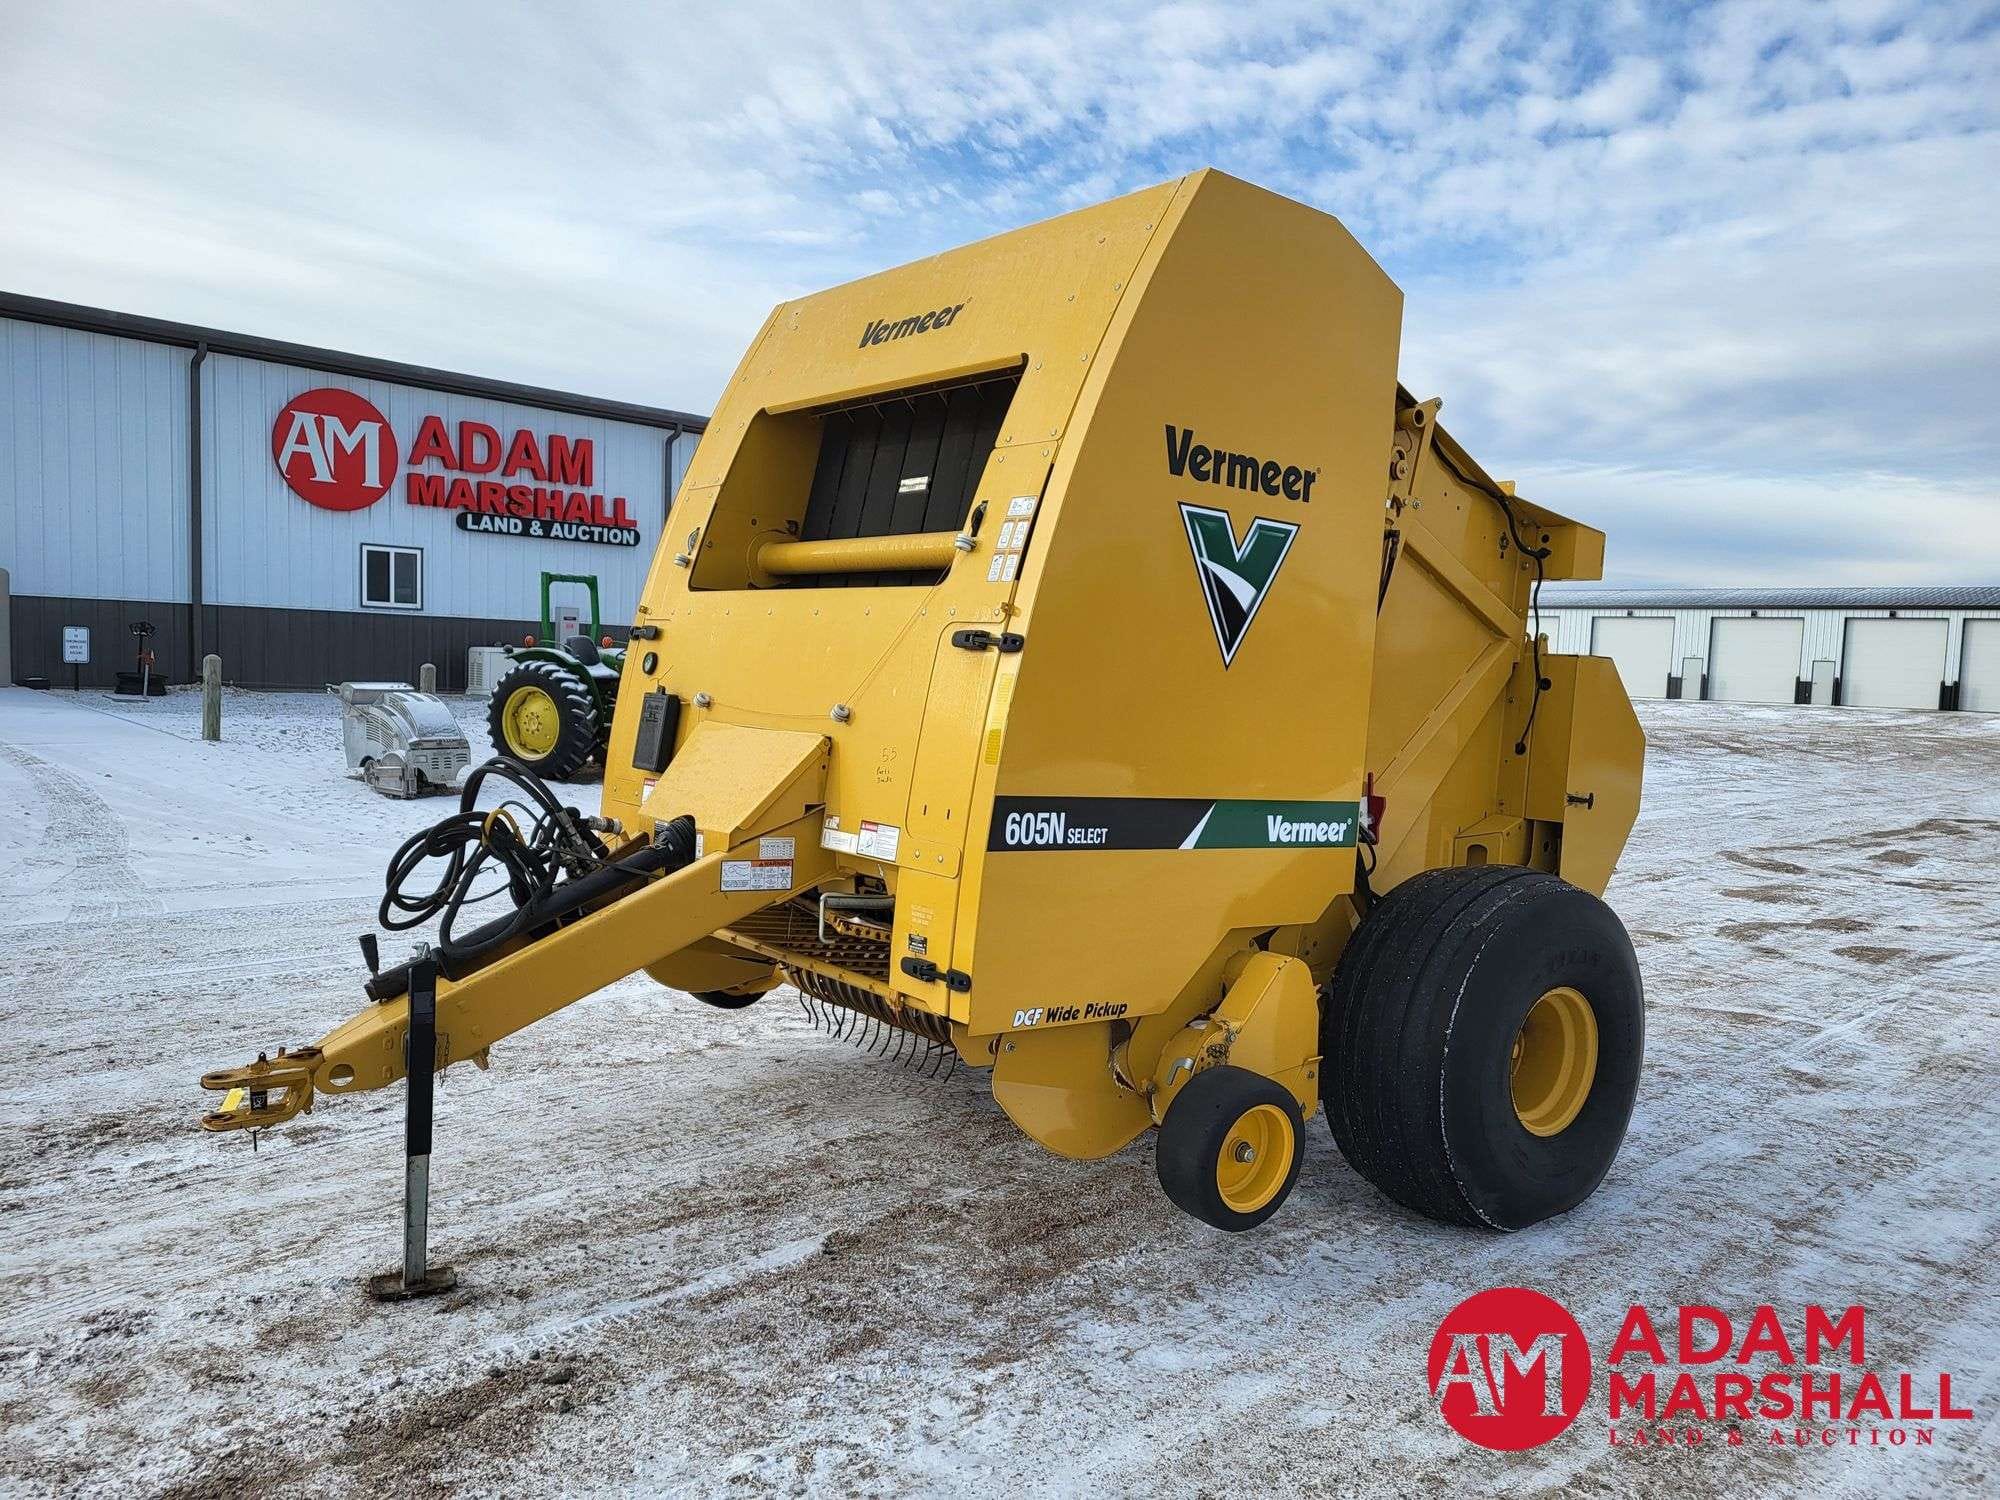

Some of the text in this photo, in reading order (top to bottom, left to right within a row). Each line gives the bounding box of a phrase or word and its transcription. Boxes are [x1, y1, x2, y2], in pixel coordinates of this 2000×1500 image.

[858, 302, 966, 349] Vermeer
[283, 410, 384, 489] AM
[407, 415, 594, 487] ADAM
[1164, 423, 1317, 503] Vermeer
[406, 473, 638, 528] MARSHALL
[466, 513, 636, 546] LAND & AUCTION
[1005, 812, 1109, 845] 605N SELECT
[1266, 814, 1348, 844] Vermeer
[1012, 1001, 1128, 1028] DCF Wide Pickup
